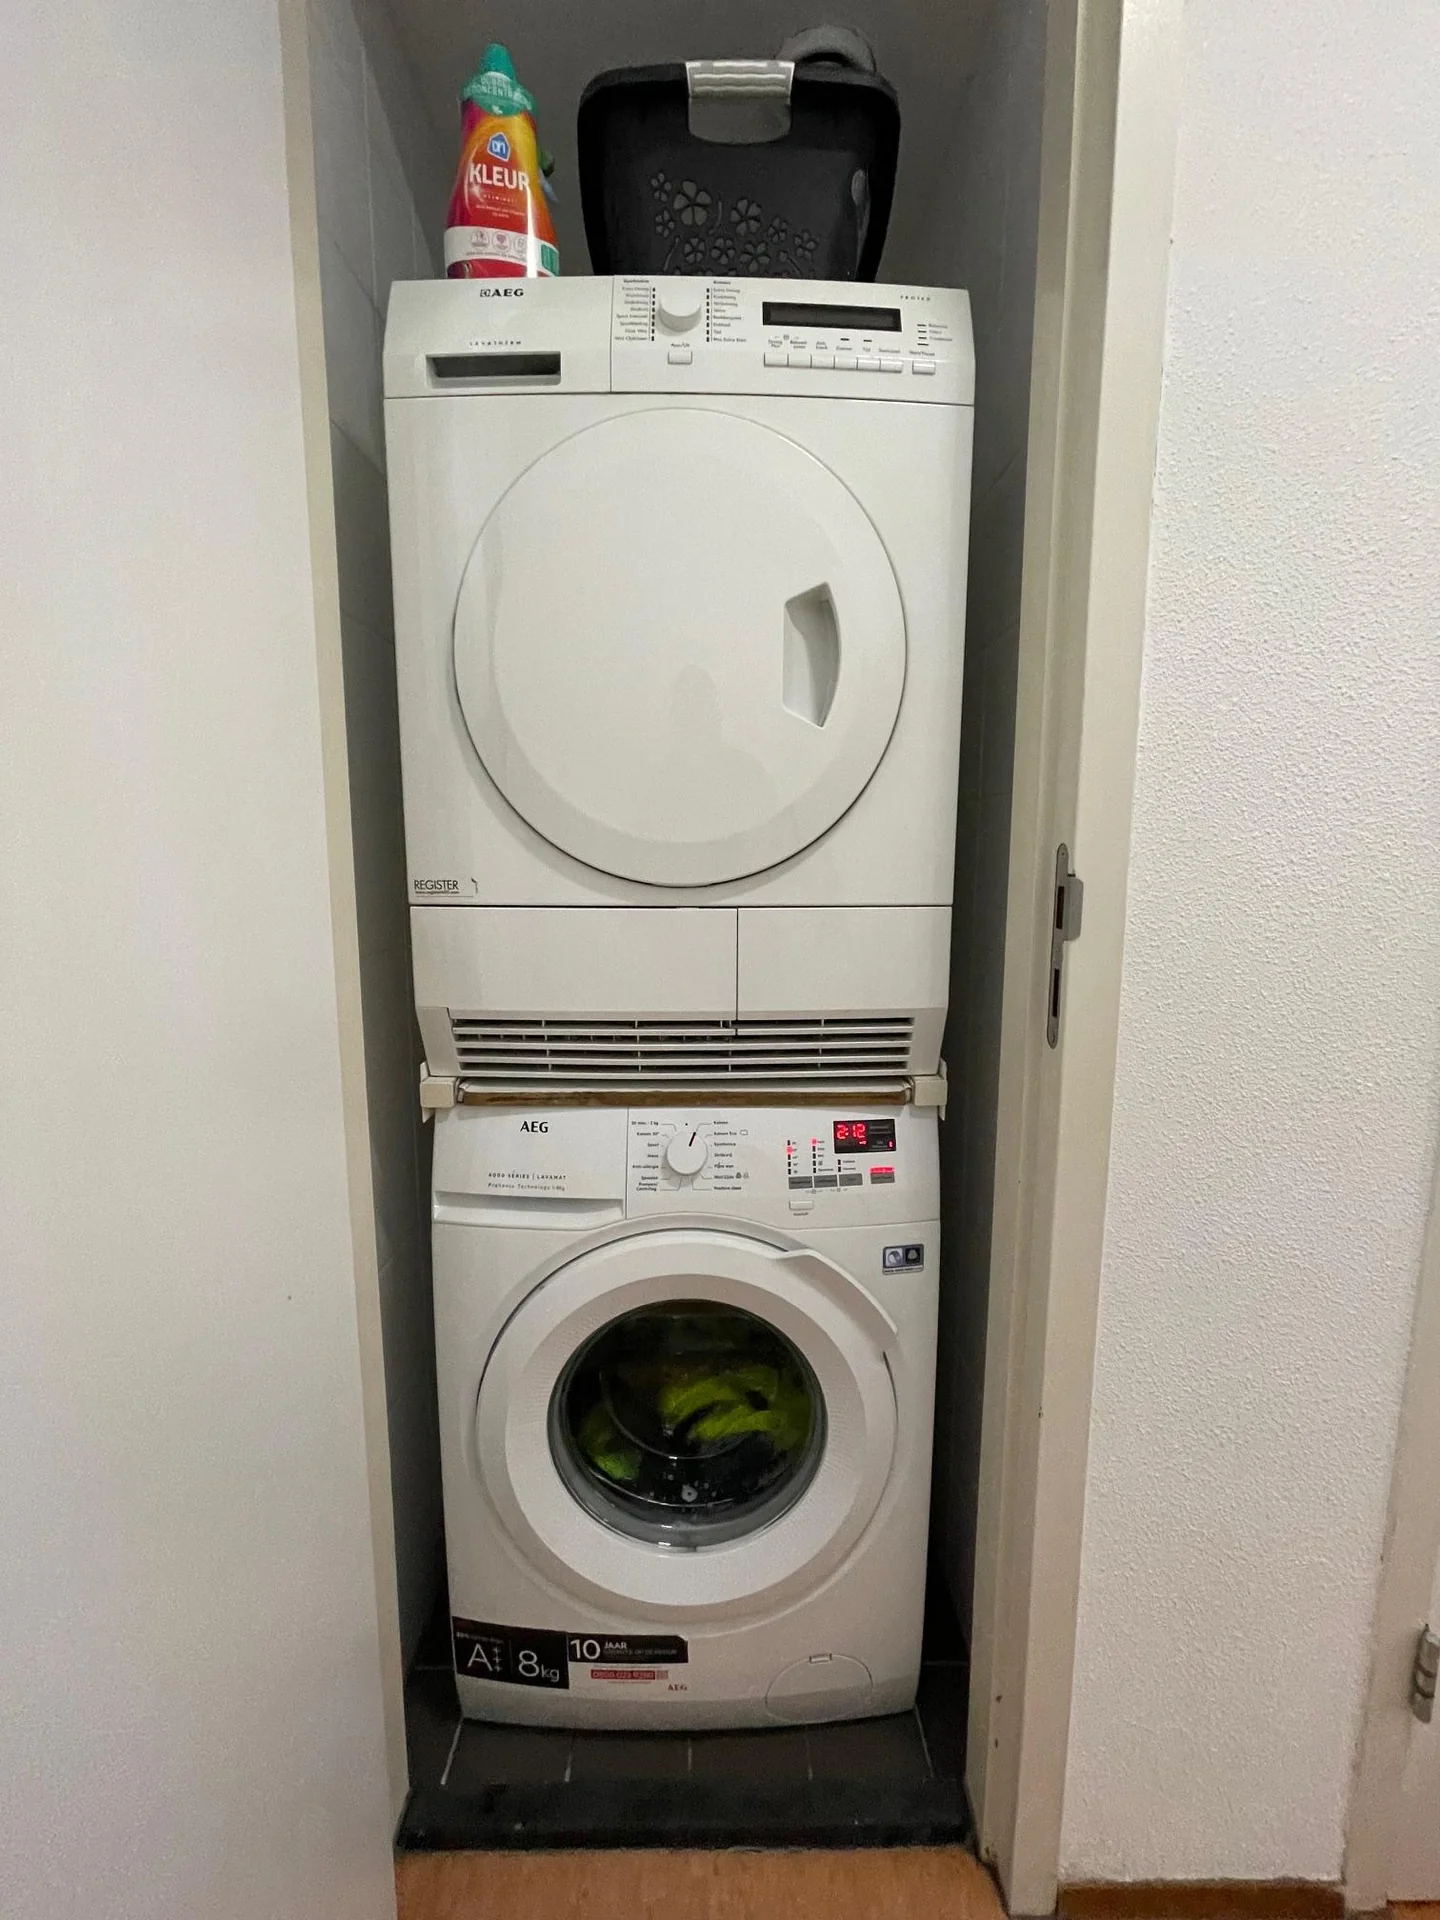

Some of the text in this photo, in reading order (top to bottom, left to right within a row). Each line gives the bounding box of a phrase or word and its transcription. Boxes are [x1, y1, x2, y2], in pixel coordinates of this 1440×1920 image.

[468, 163, 530, 191] KLEUR
[492, 288, 524, 297] AEG
[413, 879, 460, 890] REGISTER
[520, 1121, 549, 1133] AEG
[836, 1123, 866, 1140] 2:12
[570, 1639, 628, 1660] 10 JAAR
[667, 1683, 688, 1691] AEG
